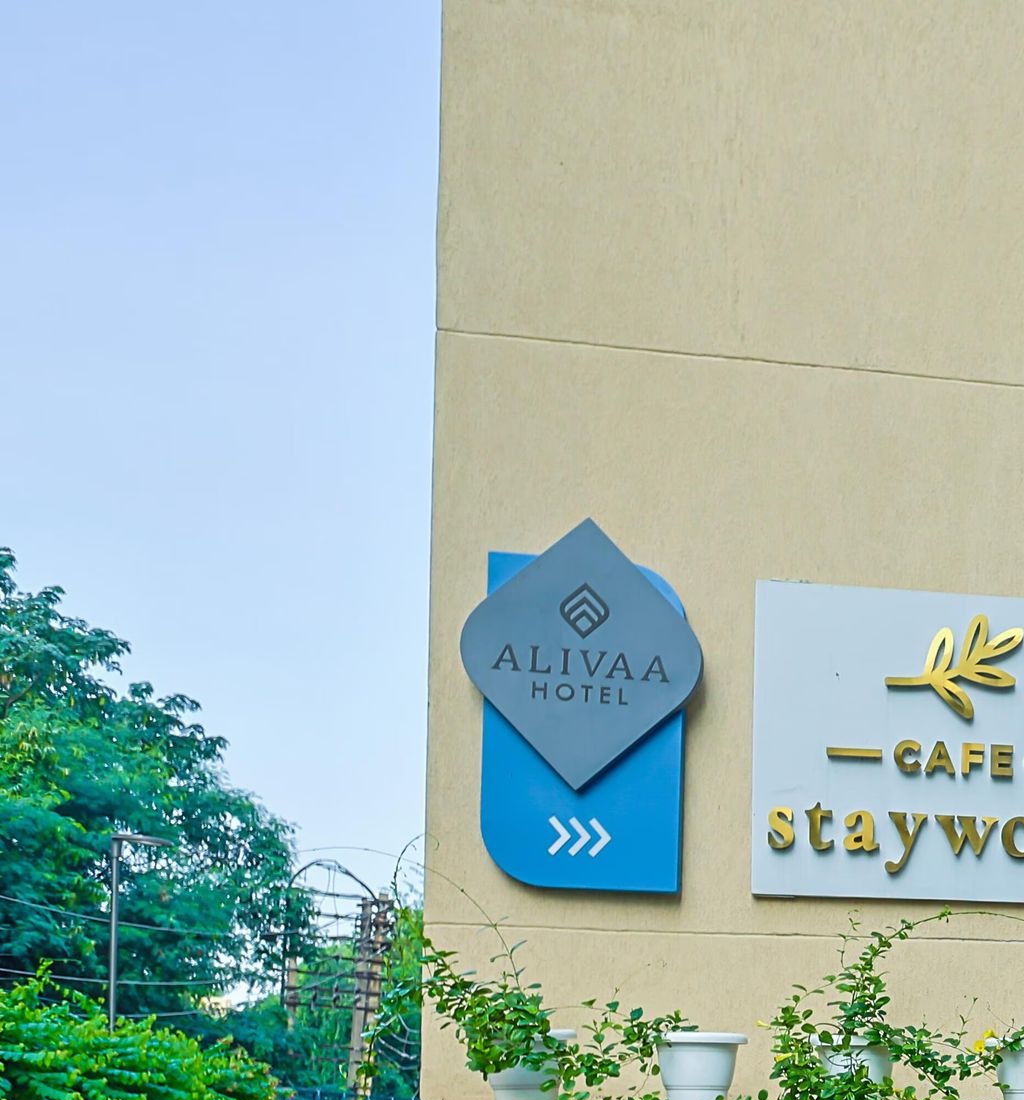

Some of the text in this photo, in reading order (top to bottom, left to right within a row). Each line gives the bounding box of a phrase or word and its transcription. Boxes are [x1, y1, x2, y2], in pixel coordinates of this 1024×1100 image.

[491, 643, 670, 683] ALIVAA
[531, 681, 629, 706] HOTEL
[893, 739, 1014, 778] CAFE
